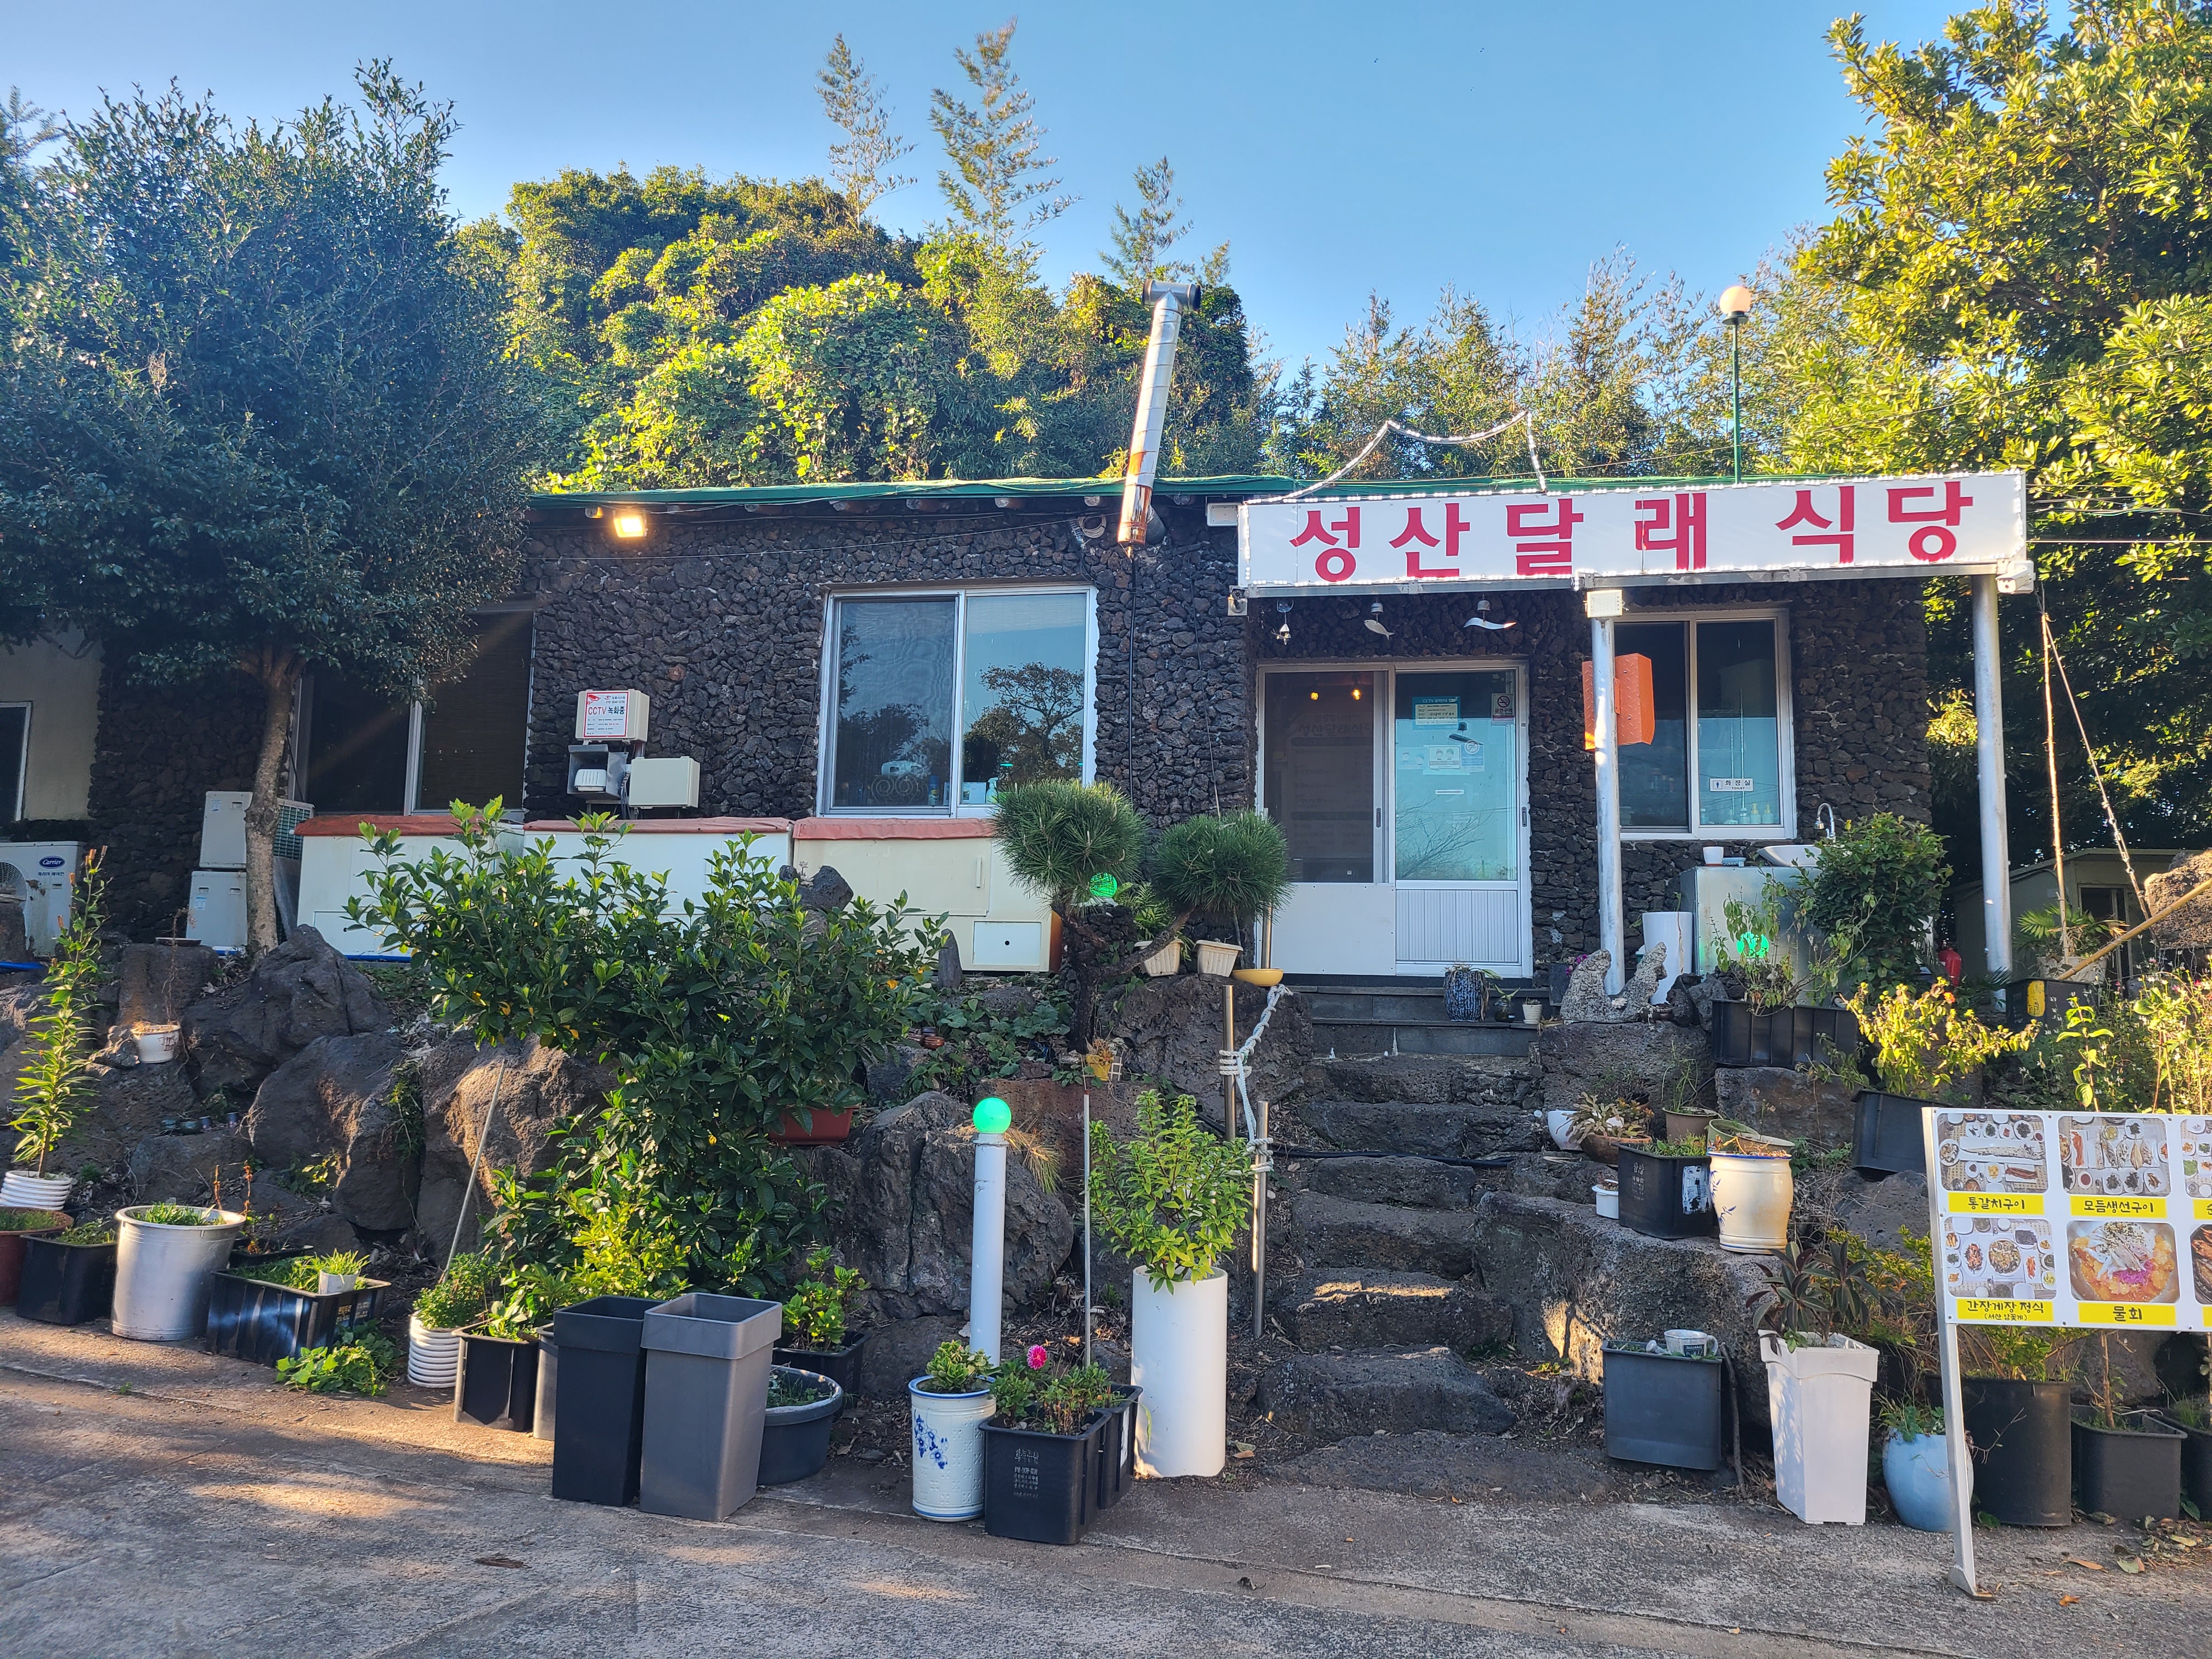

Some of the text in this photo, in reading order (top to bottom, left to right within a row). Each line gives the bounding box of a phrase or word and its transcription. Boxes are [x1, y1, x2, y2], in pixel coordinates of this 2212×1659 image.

[588, 706, 625, 715] CCTV 녹화중
[1968, 1197, 2025, 1210] 통갈치구이
[2084, 1200, 2154, 1214] 모듬생선구이
[1967, 1301, 2044, 1314] 간장게장 정식
[2113, 1306, 2142, 1322] 물회
